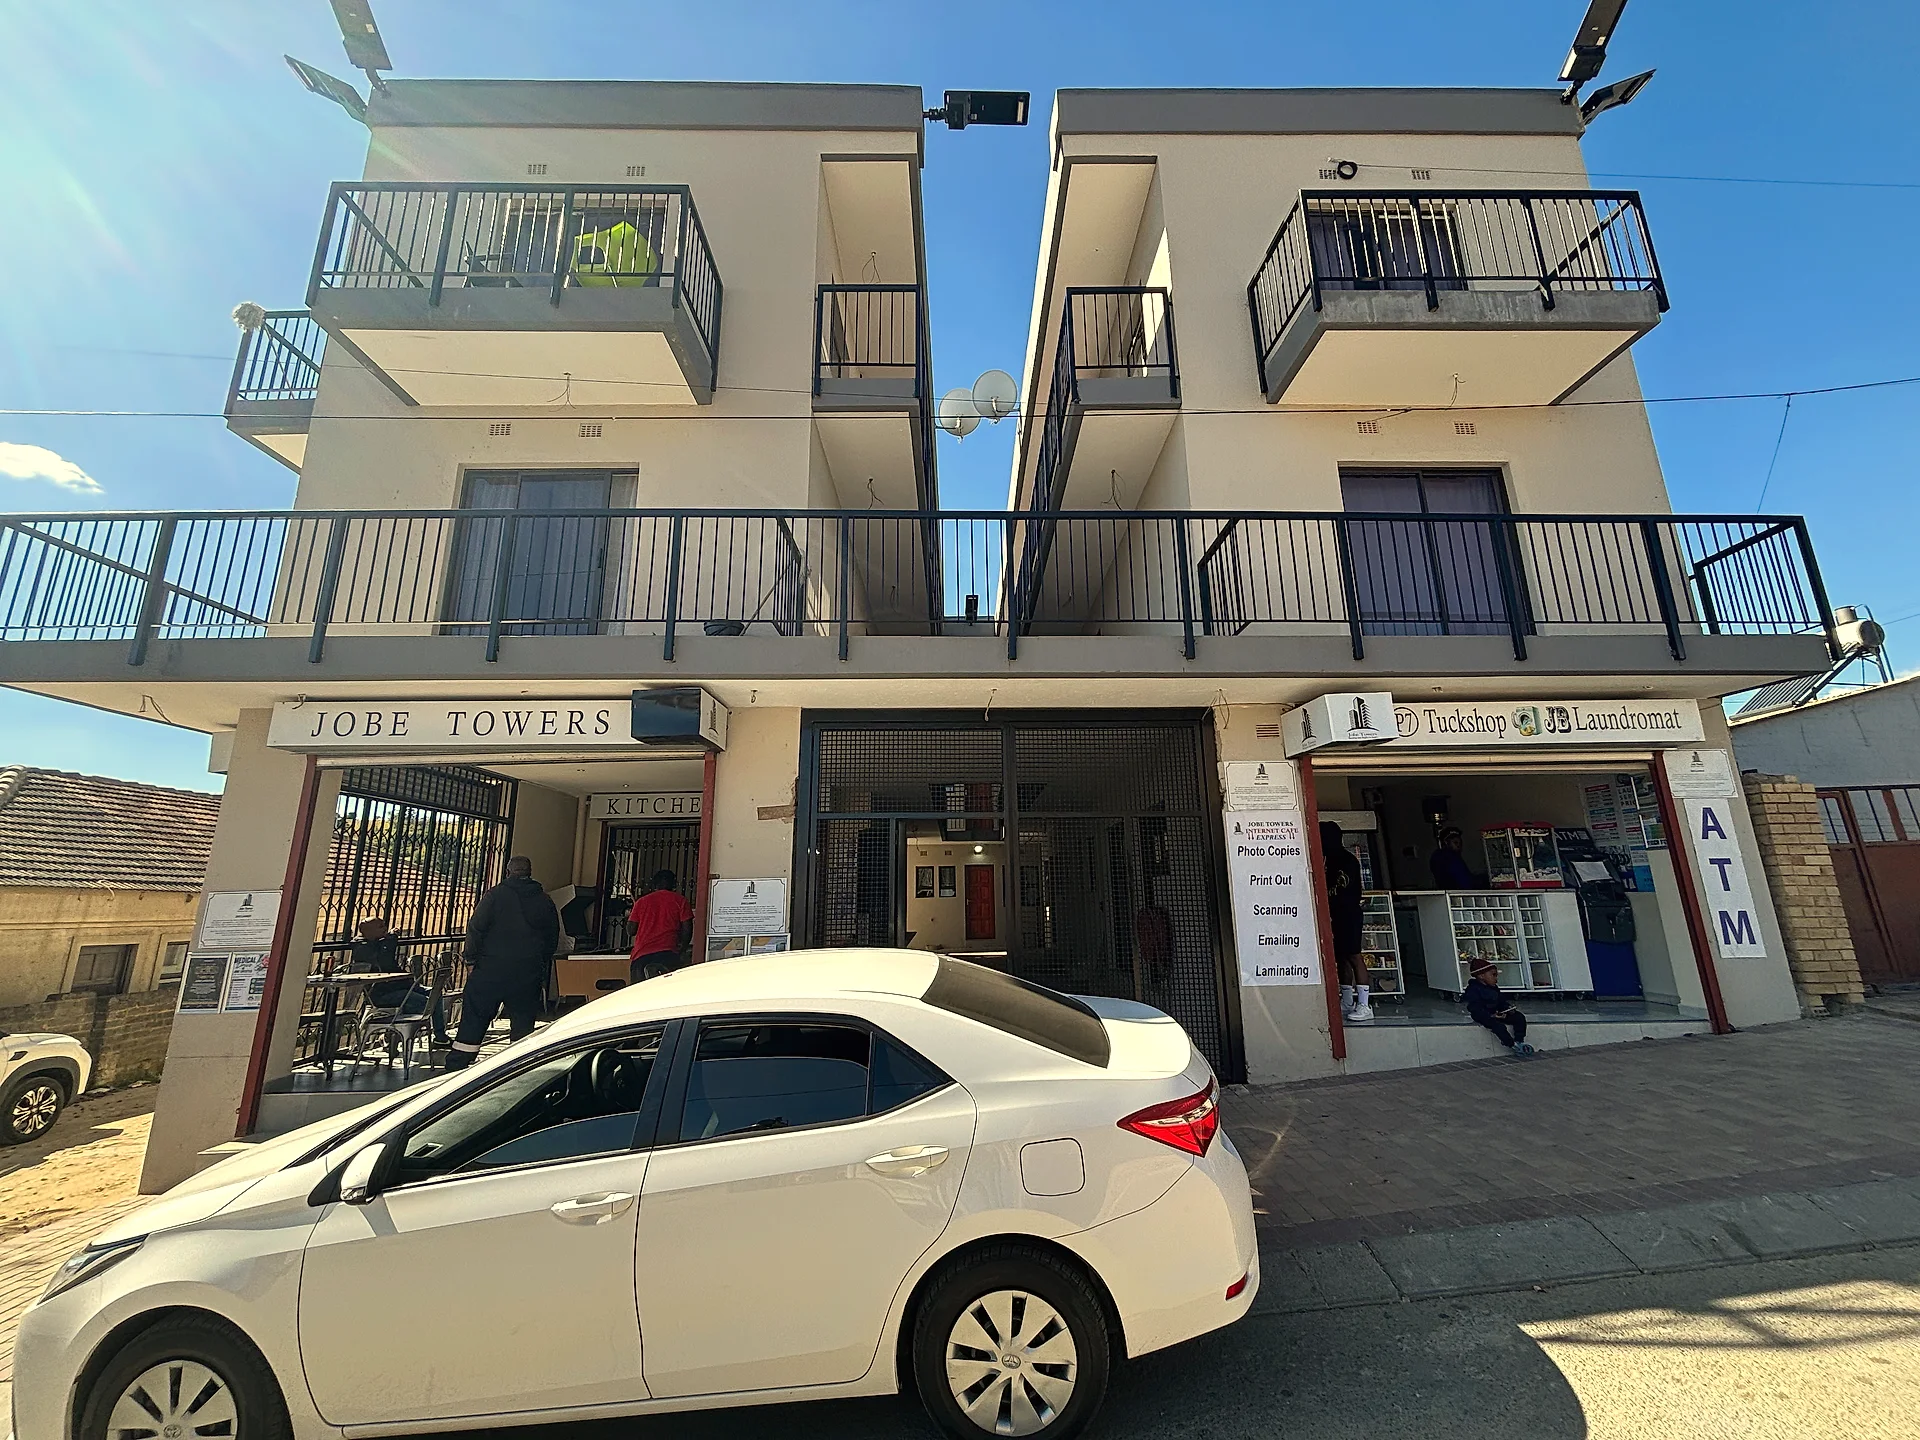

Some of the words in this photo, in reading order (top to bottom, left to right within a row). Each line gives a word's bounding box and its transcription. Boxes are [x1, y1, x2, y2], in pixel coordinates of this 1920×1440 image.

[310, 711, 410, 737] JOBE
[446, 709, 611, 737] TOWERS
[1423, 707, 1507, 739] Tuckshop
[1571, 705, 1683, 731] Laundromat
[1237, 845, 1265, 857] Photo
[1267, 845, 1301, 858] Copies
[1250, 875, 1272, 886] Print
[1274, 874, 1292, 886] Out
[1701, 807, 1757, 945] ATM
[1253, 904, 1298, 917] Scanning
[1258, 934, 1300, 948] Emailing
[1255, 965, 1309, 979] Laminating
